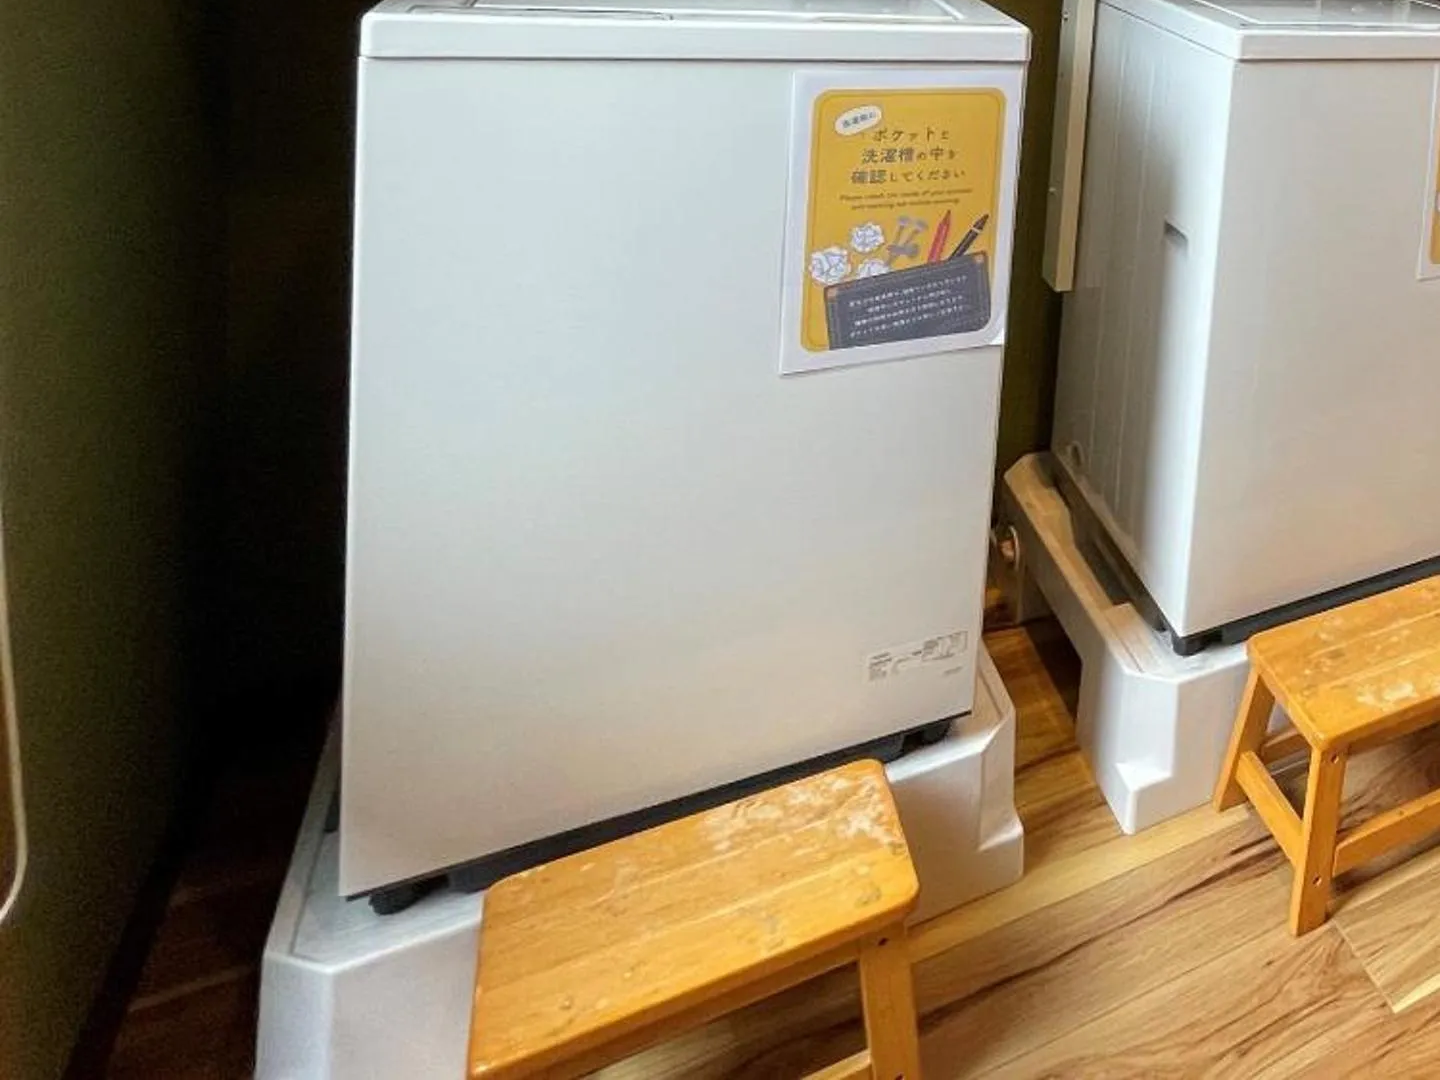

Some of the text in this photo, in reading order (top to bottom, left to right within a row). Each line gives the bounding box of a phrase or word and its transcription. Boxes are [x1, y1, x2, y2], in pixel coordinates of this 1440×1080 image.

[872, 126, 951, 143] ポケットと
[861, 146, 957, 164] 洗濯槽の中を
[851, 168, 966, 185] 確認してください
